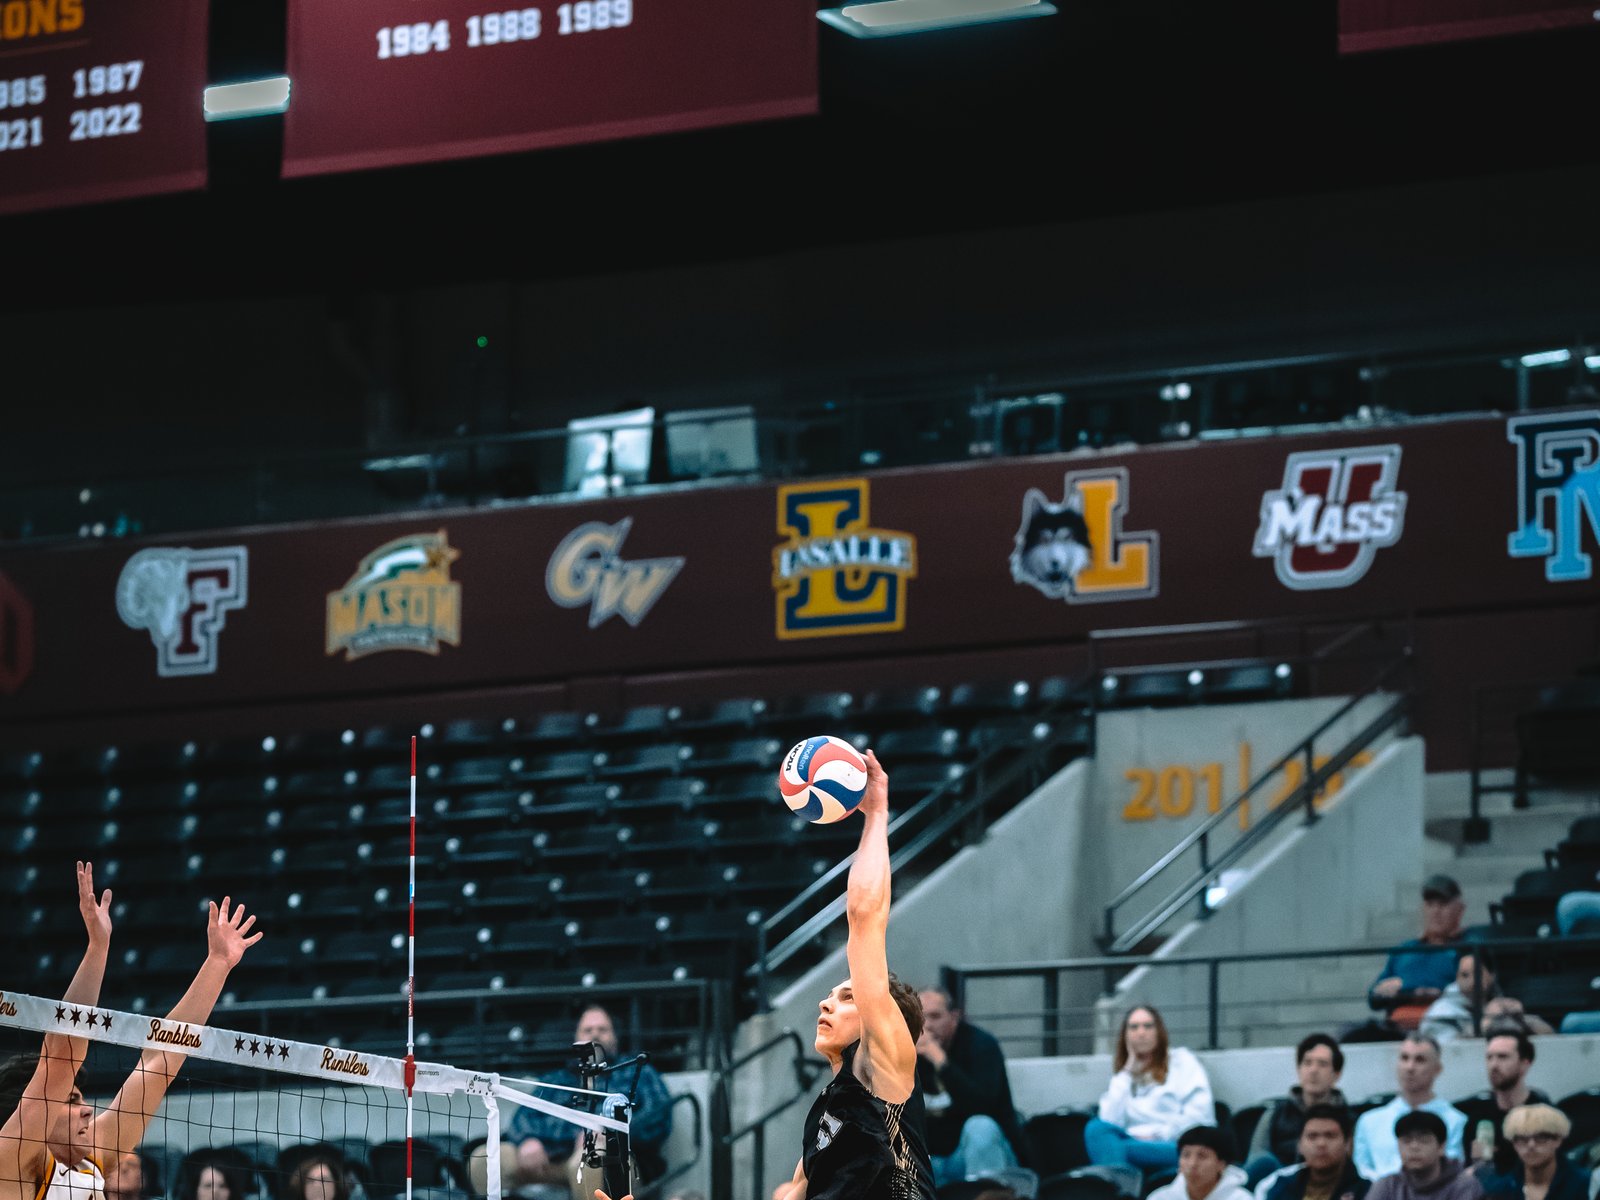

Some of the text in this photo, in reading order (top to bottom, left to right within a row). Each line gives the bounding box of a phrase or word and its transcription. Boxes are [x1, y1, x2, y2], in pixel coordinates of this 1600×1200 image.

[376, 20, 451, 60] 1984
[466, 8, 542, 47] 1988
[72, 60, 144, 98] 1987
[69, 102, 142, 141] 2022
[328, 578, 460, 645] MASON
[1122, 763, 1223, 820] 201
[147, 1018, 202, 1048] Ramblers
[321, 1048, 370, 1077] Ramblers
